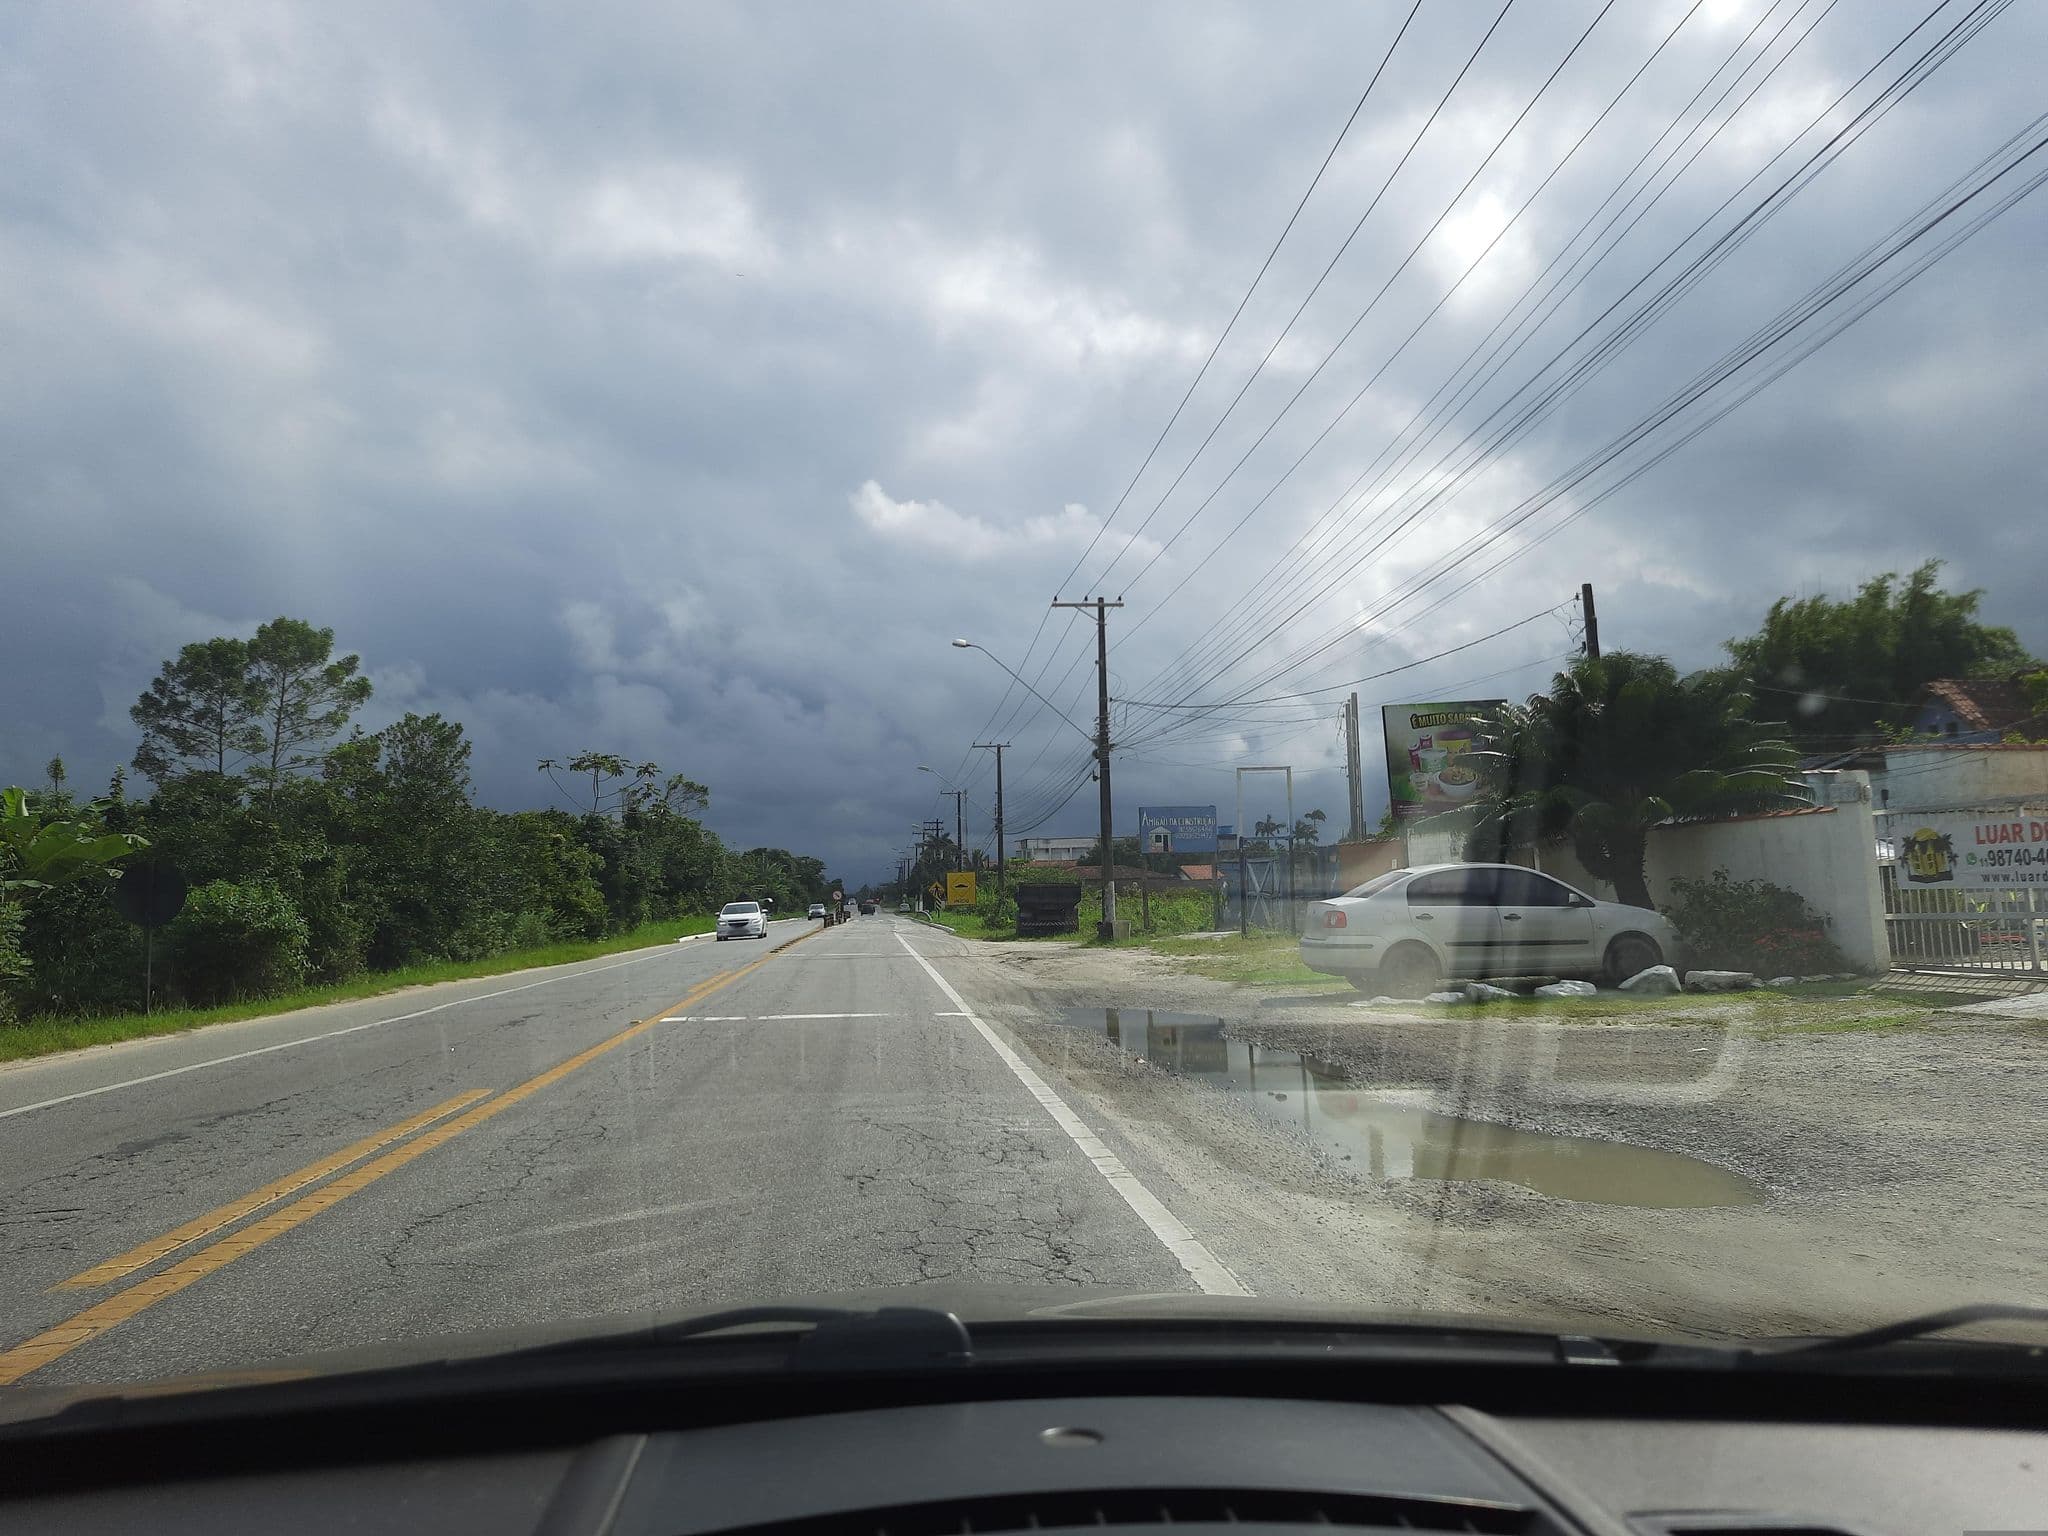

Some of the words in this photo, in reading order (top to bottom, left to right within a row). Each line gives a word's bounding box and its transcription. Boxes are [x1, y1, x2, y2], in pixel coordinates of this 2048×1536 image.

[1419, 714, 1446, 727] MUITO
[1976, 823, 2025, 845] LUAR
[2030, 821, 2048, 842] D
[1988, 848, 2048, 867] 98740-4
